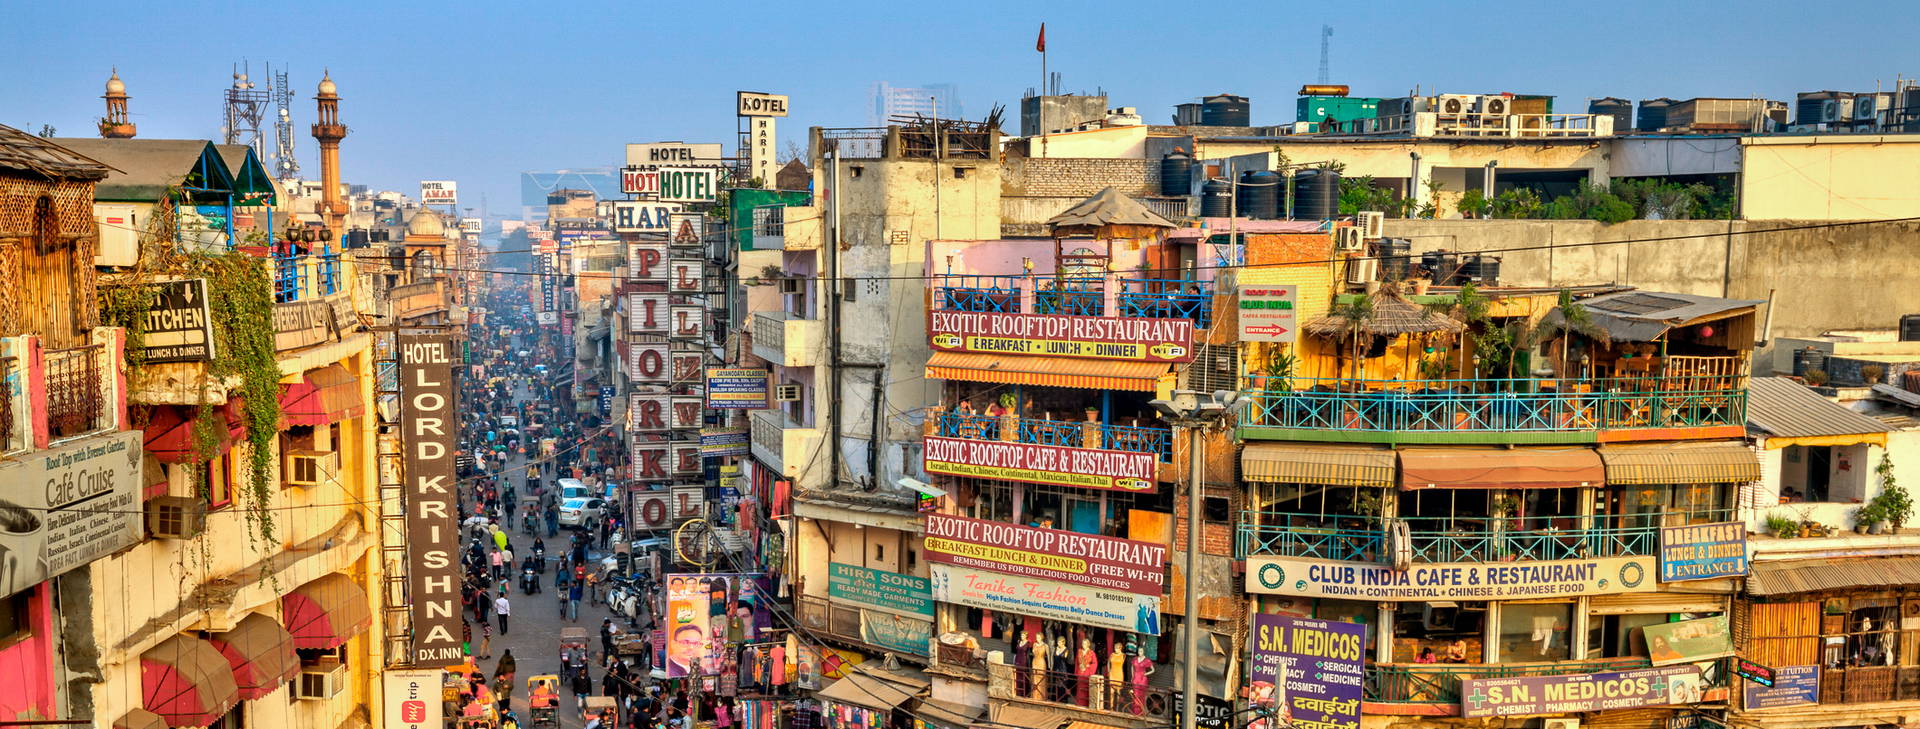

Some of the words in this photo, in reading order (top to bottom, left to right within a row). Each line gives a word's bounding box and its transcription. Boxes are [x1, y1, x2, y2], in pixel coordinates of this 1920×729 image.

[743, 98, 785, 112] HOTEL
[650, 148, 695, 160] HOTEL
[425, 190, 454, 198] AMAN
[660, 171, 714, 199] HOTEL
[617, 207, 682, 229] HAR
[1266, 300, 1292, 309] INDIA
[932, 312, 987, 334] EXOTIC
[991, 316, 1069, 337] ROOFTOP
[1073, 318, 1188, 341] RESTAURANT
[147, 348, 171, 358] LUNCH
[173, 348, 178, 356] &
[179, 346, 205, 356] DINNER
[404, 343, 449, 364] HOTEL
[974, 338, 1032, 352] BREAKFAST
[1046, 341, 1080, 355] LUNCH
[1096, 344, 1136, 357] DINNER
[414, 369, 445, 460] LORD
[46, 454, 60, 471] Roof
[61, 452, 72, 469] Top
[74, 449, 86, 464] with
[87, 445, 106, 458] Everest
[107, 440, 126, 454] Garden
[926, 439, 966, 464] EXOTIC
[970, 443, 1023, 468] ROOFTOP
[1026, 447, 1056, 471] CAFE
[1060, 449, 1069, 472] &
[1072, 450, 1152, 478] RESTAURANT
[952, 464, 973, 473] Indian,
[46, 472, 74, 507] Café
[78, 466, 114, 498] Cruise
[927, 515, 979, 541] EXOTIC
[982, 524, 1054, 551] ROOFTOP
[1058, 534, 1165, 567] RESTAURANT
[1665, 525, 1742, 546] BREAKFAST
[418, 476, 455, 644] KRISHNA
[928, 539, 987, 556] BREAKFAST
[990, 549, 1026, 562] LUNCH
[1030, 556, 1038, 564] &
[1041, 556, 1083, 571] DINNER
[1090, 563, 1124, 577] (FREE
[1127, 568, 1164, 585] WI-FI)
[1665, 546, 1695, 561] LUNCH
[1698, 546, 1705, 559] &
[1708, 544, 1744, 558] DINNER
[838, 567, 876, 580] HIRA
[880, 574, 924, 589] SONS
[953, 556, 995, 568] REMEMBER
[1025, 567, 1067, 580] DELICIOUS
[1068, 574, 1090, 583] FOOD
[1092, 577, 1130, 589] SERVICES
[1309, 565, 1355, 584] CLUB
[1361, 568, 1410, 586] INDIA
[1416, 568, 1461, 586] CAFE
[1468, 568, 1480, 585] &
[1487, 563, 1597, 584] RESTAURANT
[1677, 562, 1734, 576] ENTRANCE
[838, 584, 862, 593] READY
[862, 589, 882, 598] MADE
[884, 593, 924, 606] GARMENTS
[964, 574, 1016, 594] Tanika
[1023, 582, 1088, 605] Fashion
[1322, 585, 1357, 595] INDIAN
[1366, 588, 1439, 597] CONTINENTAL
[1448, 587, 1493, 596] CHINESE
[1507, 586, 1556, 595] JAPANESE
[1559, 583, 1584, 592] FOOD
[986, 593, 999, 602] High
[1000, 595, 1021, 604] Fashion
[1070, 606, 1084, 615] Belly
[1259, 625, 1288, 652] S.N.
[1292, 628, 1360, 661] MEDICOS
[1263, 655, 1298, 667] CHEMIST
[1323, 661, 1362, 674] SERGICAL
[1262, 666, 1305, 679] PHAMACY
[1322, 673, 1361, 686] MEDICINE
[408, 682, 419, 699] trip
[1286, 681, 1326, 694] COSMETIC
[1488, 685, 1536, 704] S.N.
[1544, 677, 1649, 702] MEDICOS
[1175, 700, 1230, 720] EOTIC
[1496, 705, 1536, 714] CHEMIST
[1545, 701, 1593, 712] PHARMACY
[1602, 698, 1643, 708] COSMETIC
